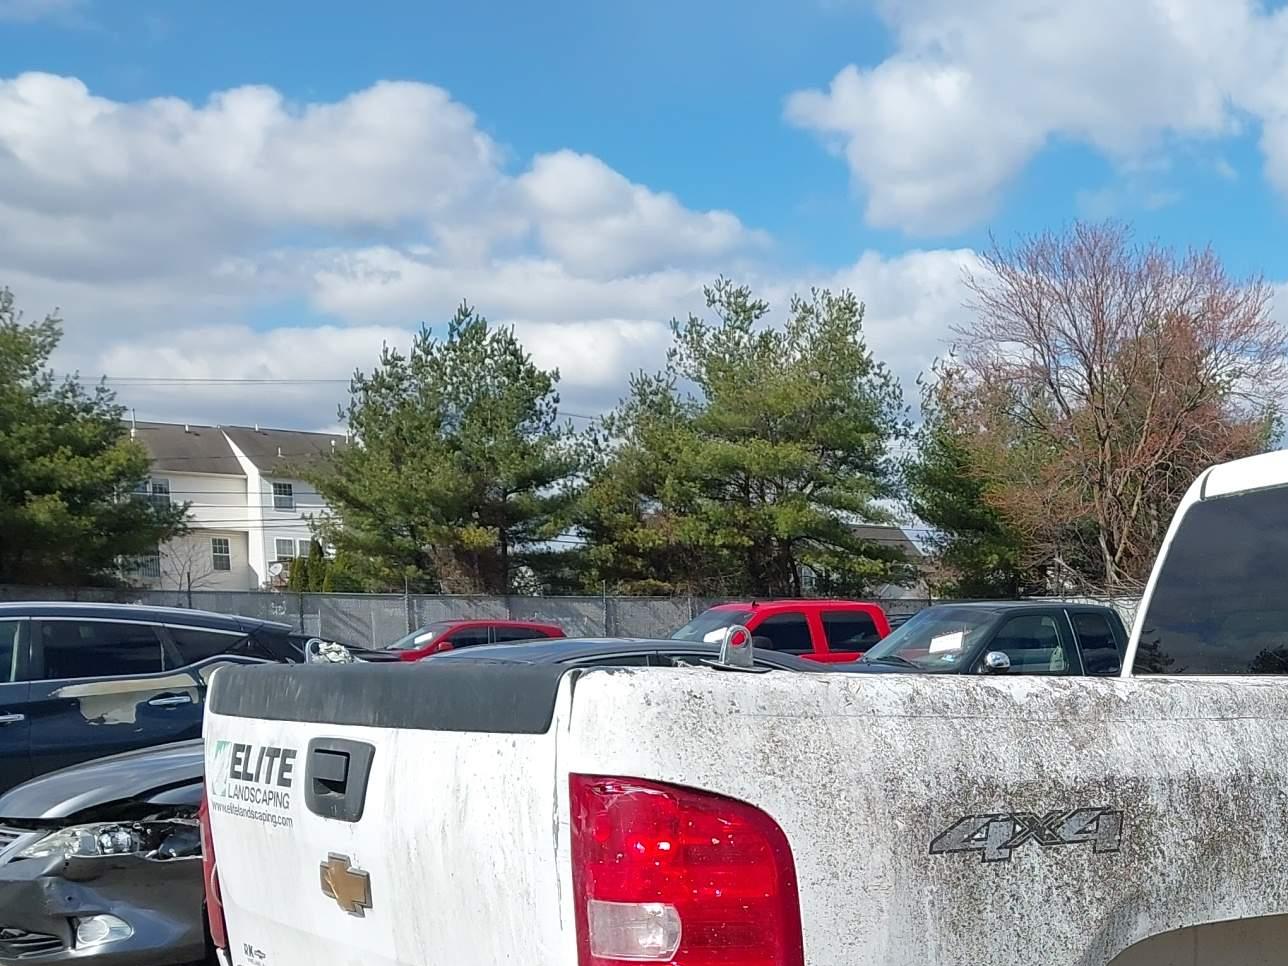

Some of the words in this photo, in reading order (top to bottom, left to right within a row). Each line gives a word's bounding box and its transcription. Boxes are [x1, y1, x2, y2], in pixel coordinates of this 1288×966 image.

[229, 743, 298, 788] ELITE
[227, 783, 291, 809] LANDSCAPING
[212, 801, 294, 828] www.elitelandscaping.com
